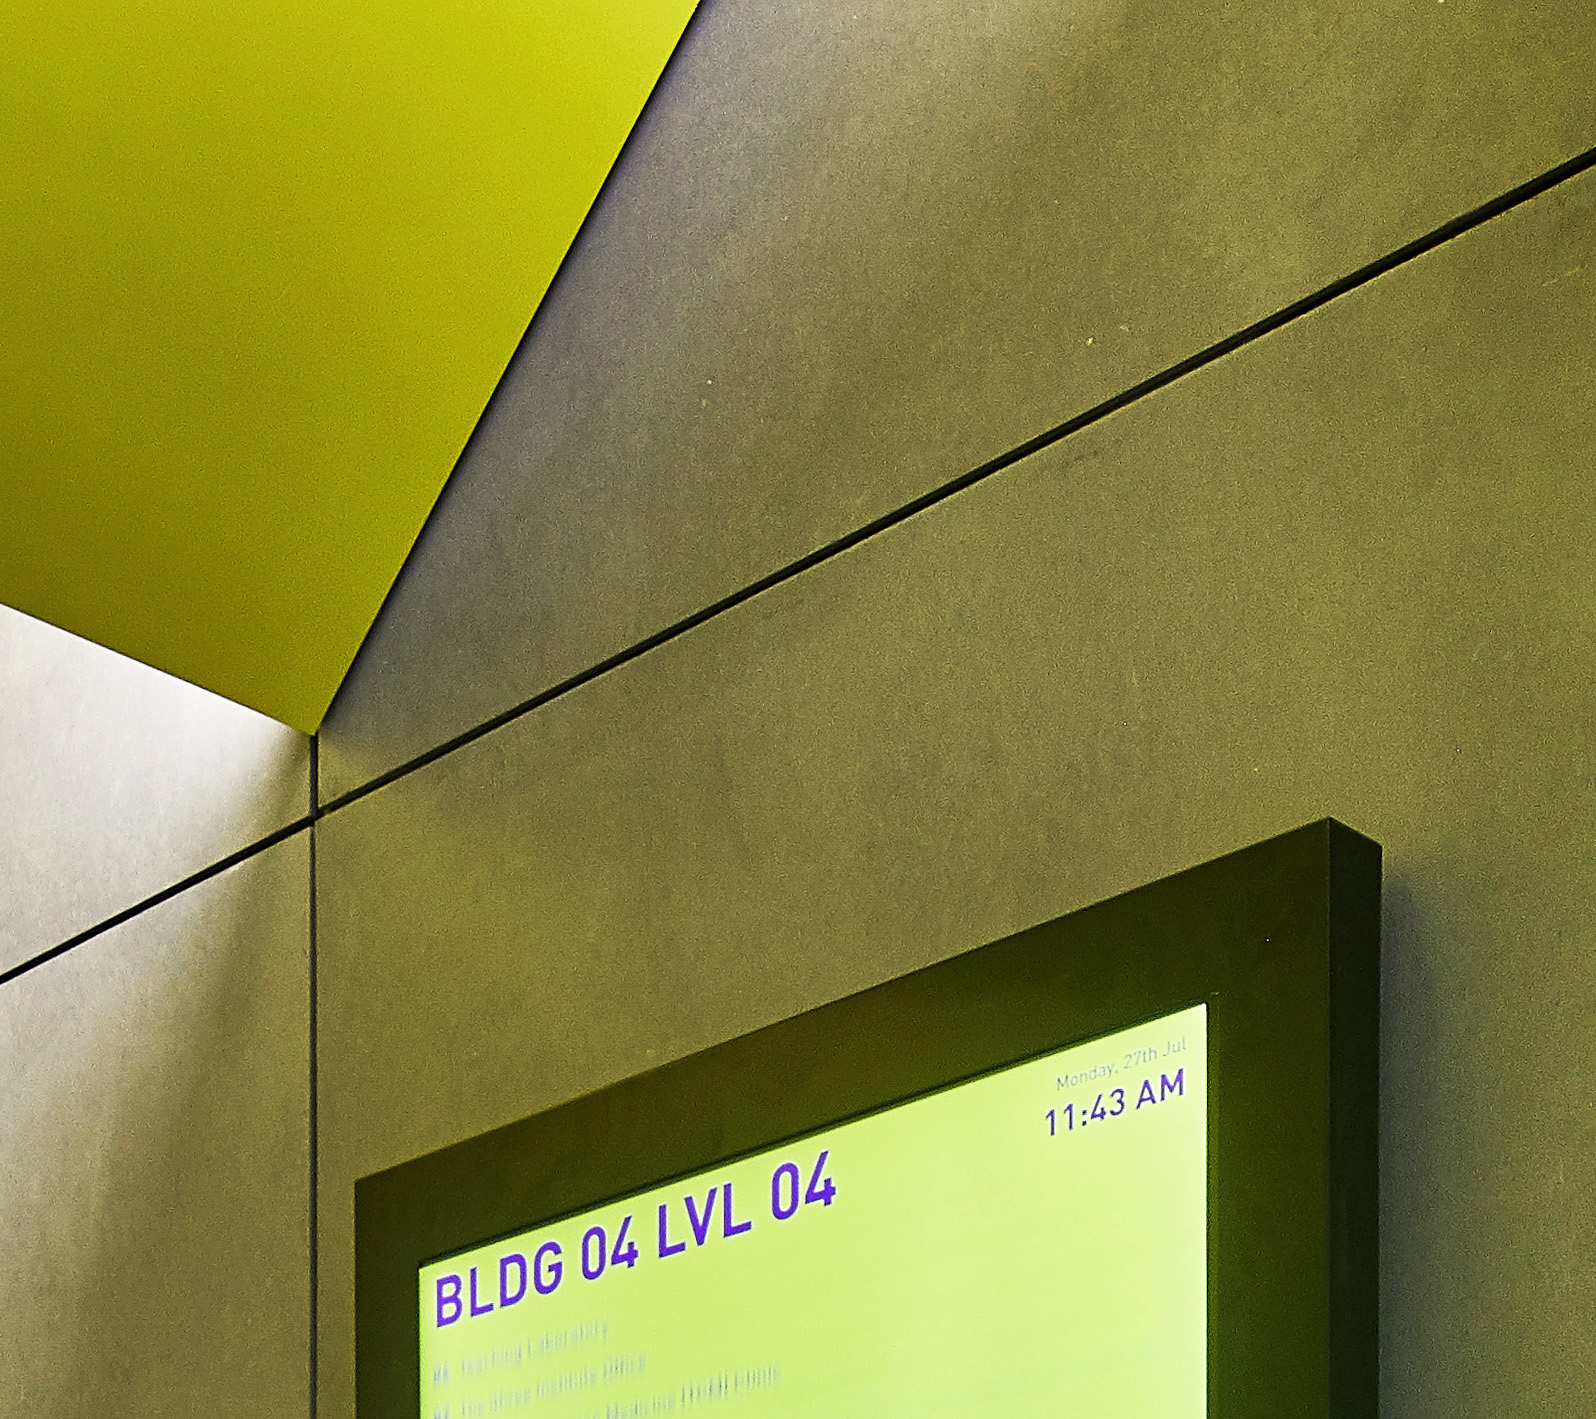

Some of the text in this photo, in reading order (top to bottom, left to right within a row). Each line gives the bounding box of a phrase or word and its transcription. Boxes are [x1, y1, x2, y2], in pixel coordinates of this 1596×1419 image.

[1057, 1037, 1187, 1091] Monday, 27th Jul
[1046, 1068, 1183, 1136] 11:43 AM
[437, 1151, 836, 1328] BLDG 04 LVL 04
